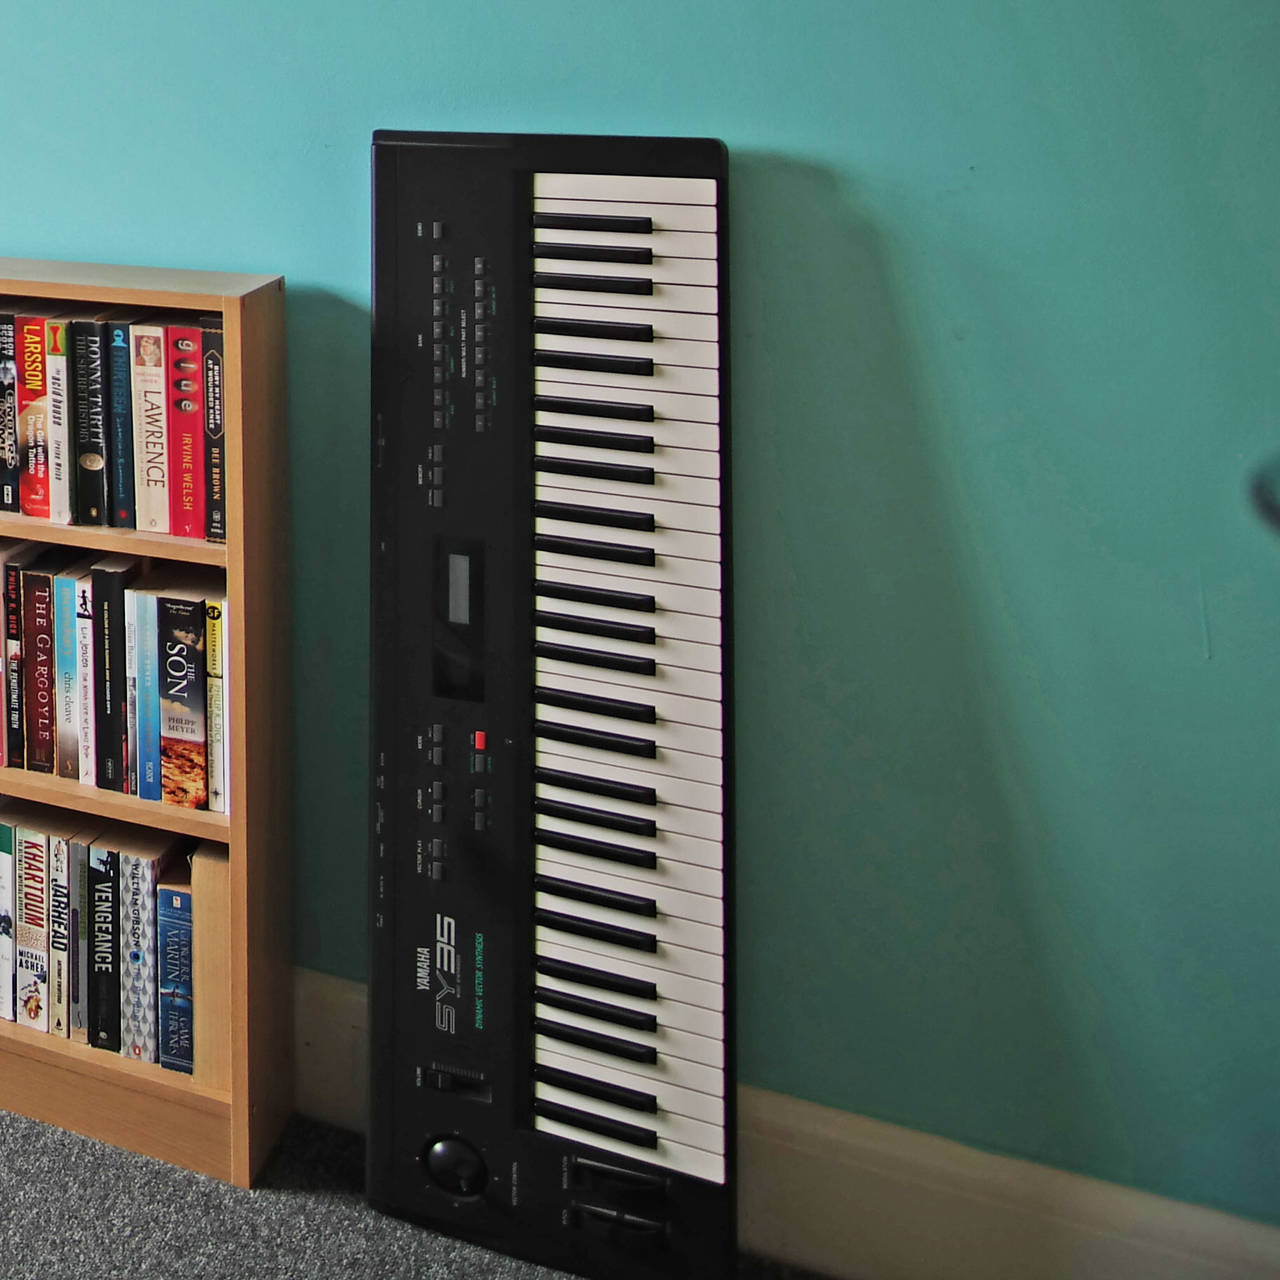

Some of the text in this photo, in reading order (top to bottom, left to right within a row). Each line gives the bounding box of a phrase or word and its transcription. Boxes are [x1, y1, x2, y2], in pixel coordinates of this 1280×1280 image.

[24, 325, 42, 390] LARSSON
[207, 359, 214, 368] AT
[77, 336, 89, 444] THE SECRET HISTORY
[87, 336, 104, 446] DONNA TARTT
[207, 370, 215, 407] WOUNDED
[27, 416, 37, 474] Dragon Tattoo
[36, 414, 45, 478] The Girl with the
[144, 390, 166, 488] LAWRENCE
[182, 433, 193, 510] IRVINE WELSH
[212, 447, 221, 499] DEE BROWN
[35, 588, 51, 740] THE GARGOYLE
[64, 672, 73, 693] chris
[165, 642, 188, 699] SON
[187, 663, 195, 682] THE
[64, 696, 74, 724] cleave
[167, 725, 198, 734] MEYER
[168, 717, 196, 726] PHILIPP
[23, 840, 44, 929] KHARTOUM
[131, 863, 141, 947] WILLIAM GIBSON
[51, 878, 68, 952] JARHEAD
[94, 882, 113, 973] VENGEANCE
[18, 950, 44, 963] MICHAEL
[18, 960, 45, 973] ASHER
[167, 928, 179, 981] MARTIN
[416, 947, 430, 990] YAMAHA
[435, 913, 456, 1035] SY35
[474, 933, 484, 1030] DYNAMIC VECTOR SYNTHESIS
